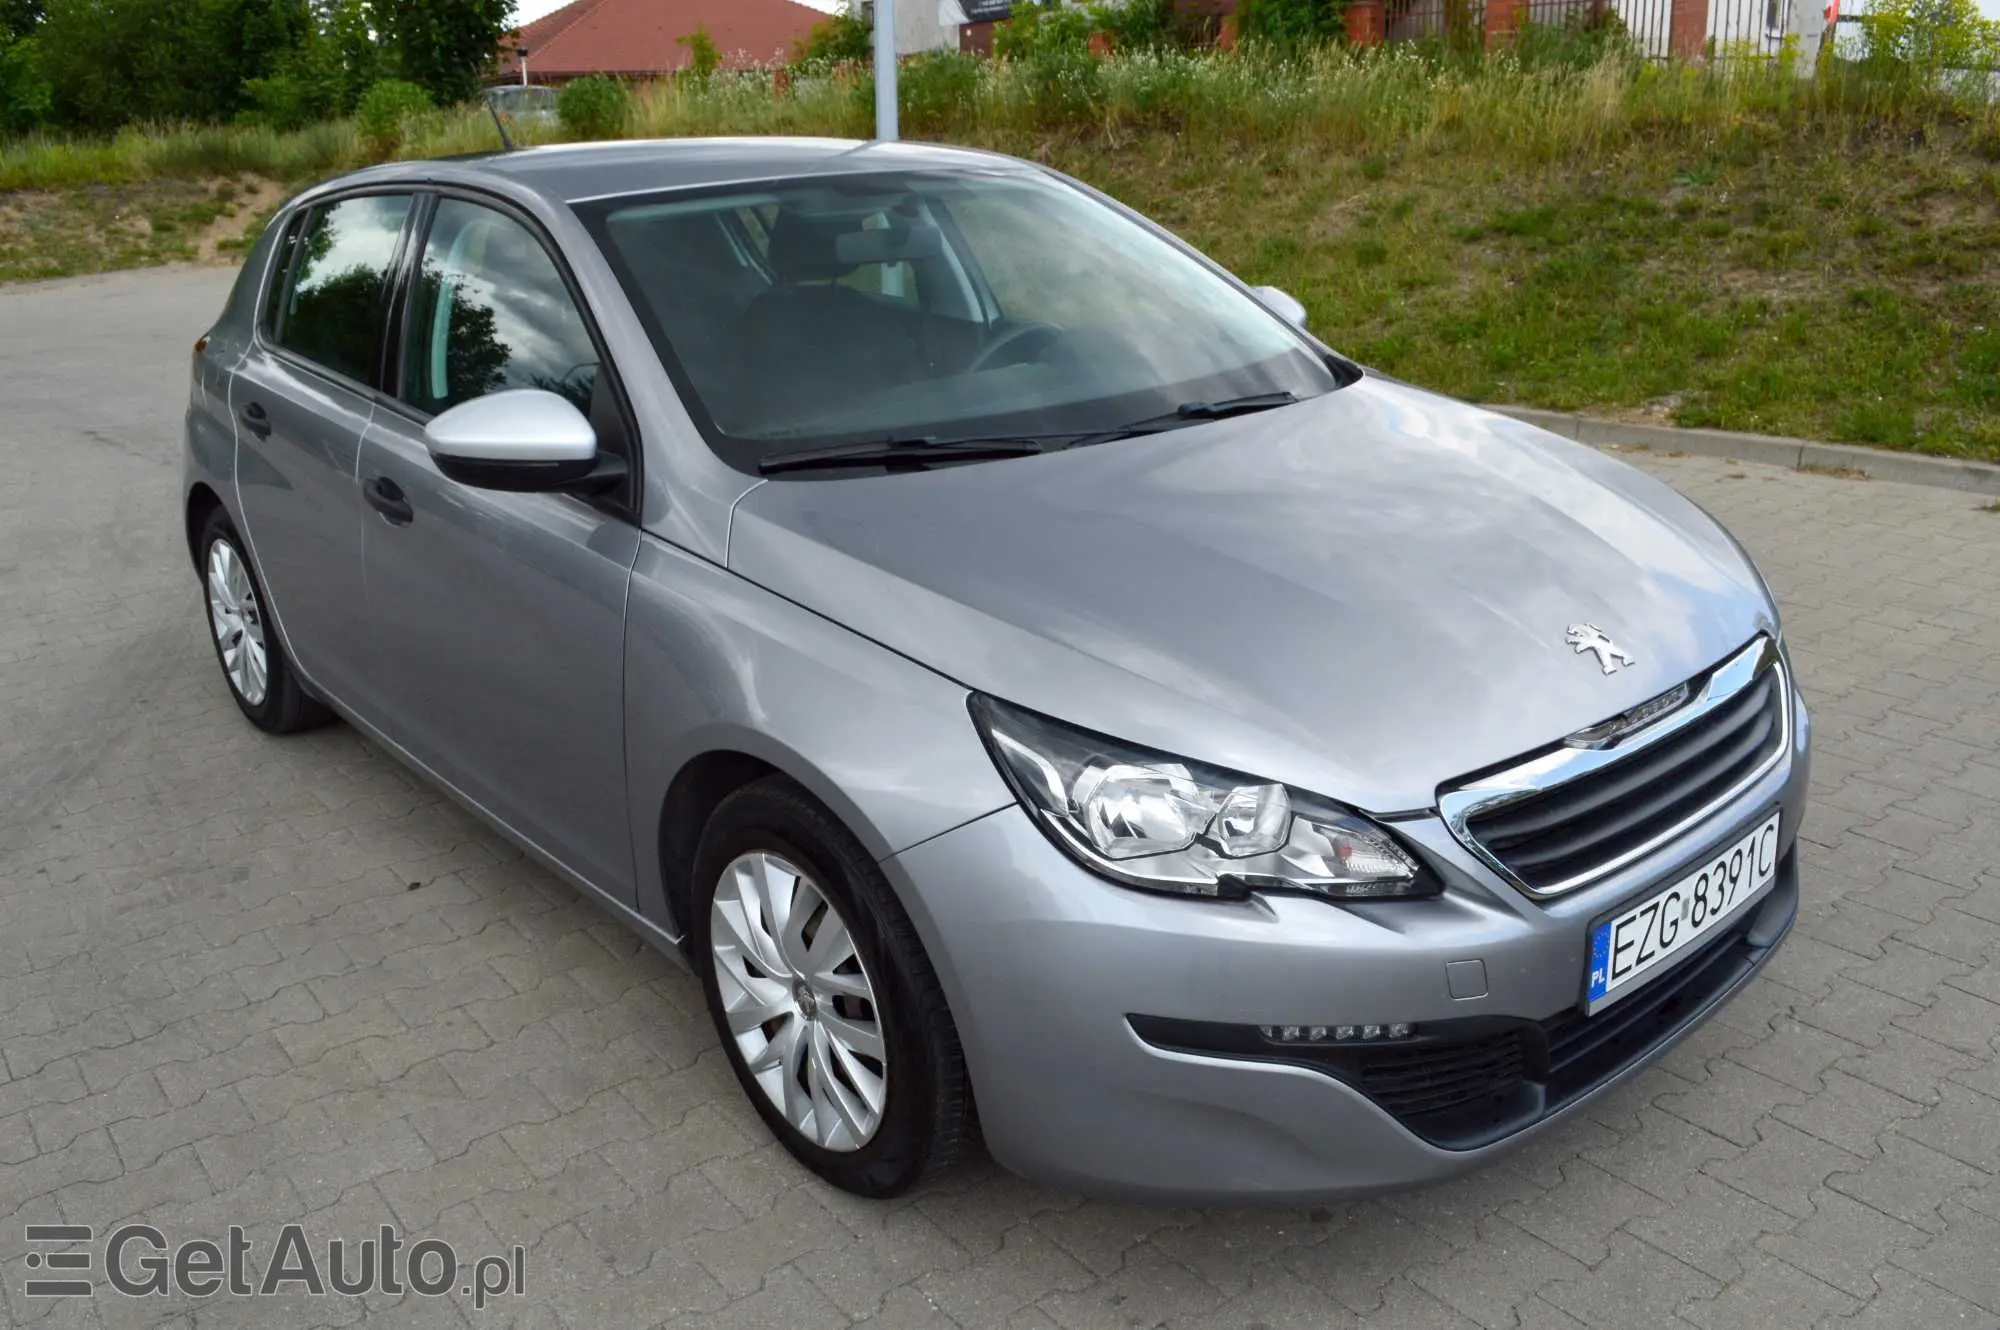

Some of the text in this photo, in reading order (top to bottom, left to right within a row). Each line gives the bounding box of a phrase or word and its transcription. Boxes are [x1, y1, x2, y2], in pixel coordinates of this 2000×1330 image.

[1611, 824, 1774, 980] EZG 8391C
[1591, 967, 1605, 988] PL
